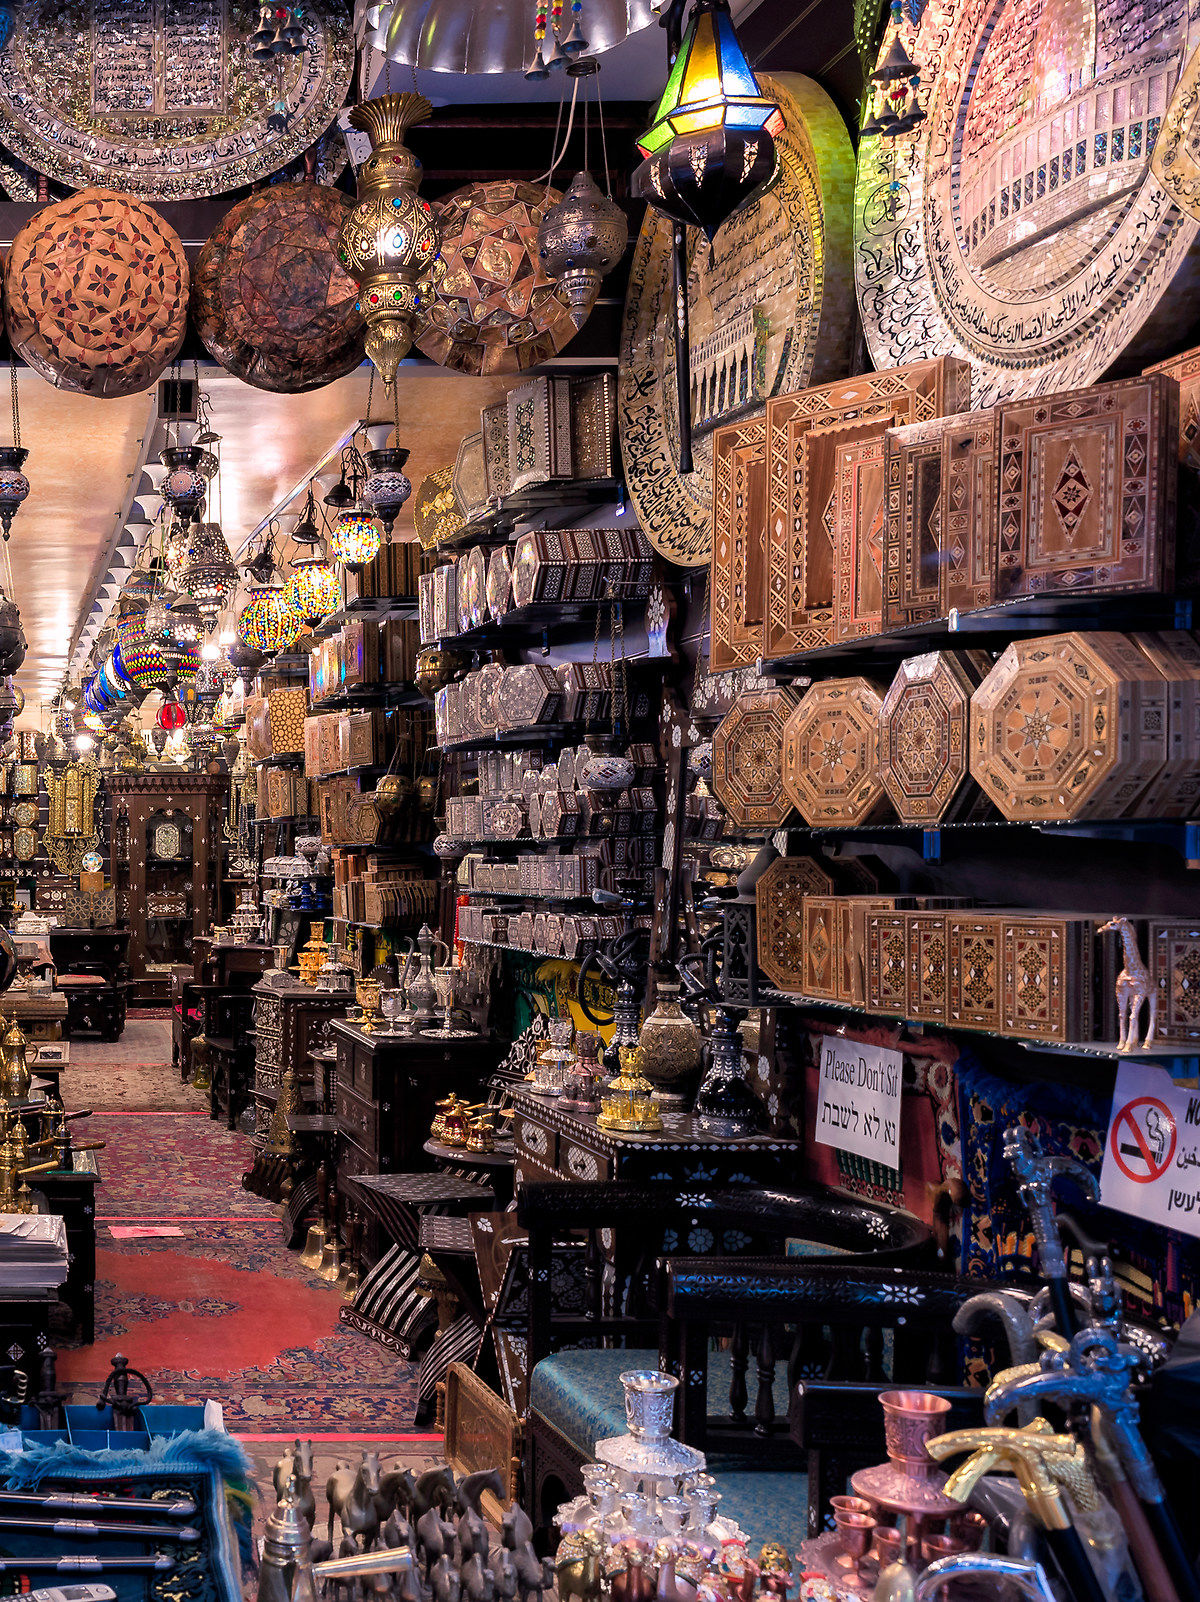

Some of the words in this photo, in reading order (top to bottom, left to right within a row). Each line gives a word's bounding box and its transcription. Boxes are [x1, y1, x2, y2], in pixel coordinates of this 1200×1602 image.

[825, 1049, 856, 1086] Please
[857, 1056, 885, 1094] Don't
[886, 1064, 899, 1099] Sit
[821, 1100, 860, 1133] לשבת
[863, 1106, 882, 1140] לא
[884, 1118, 896, 1146] נא
